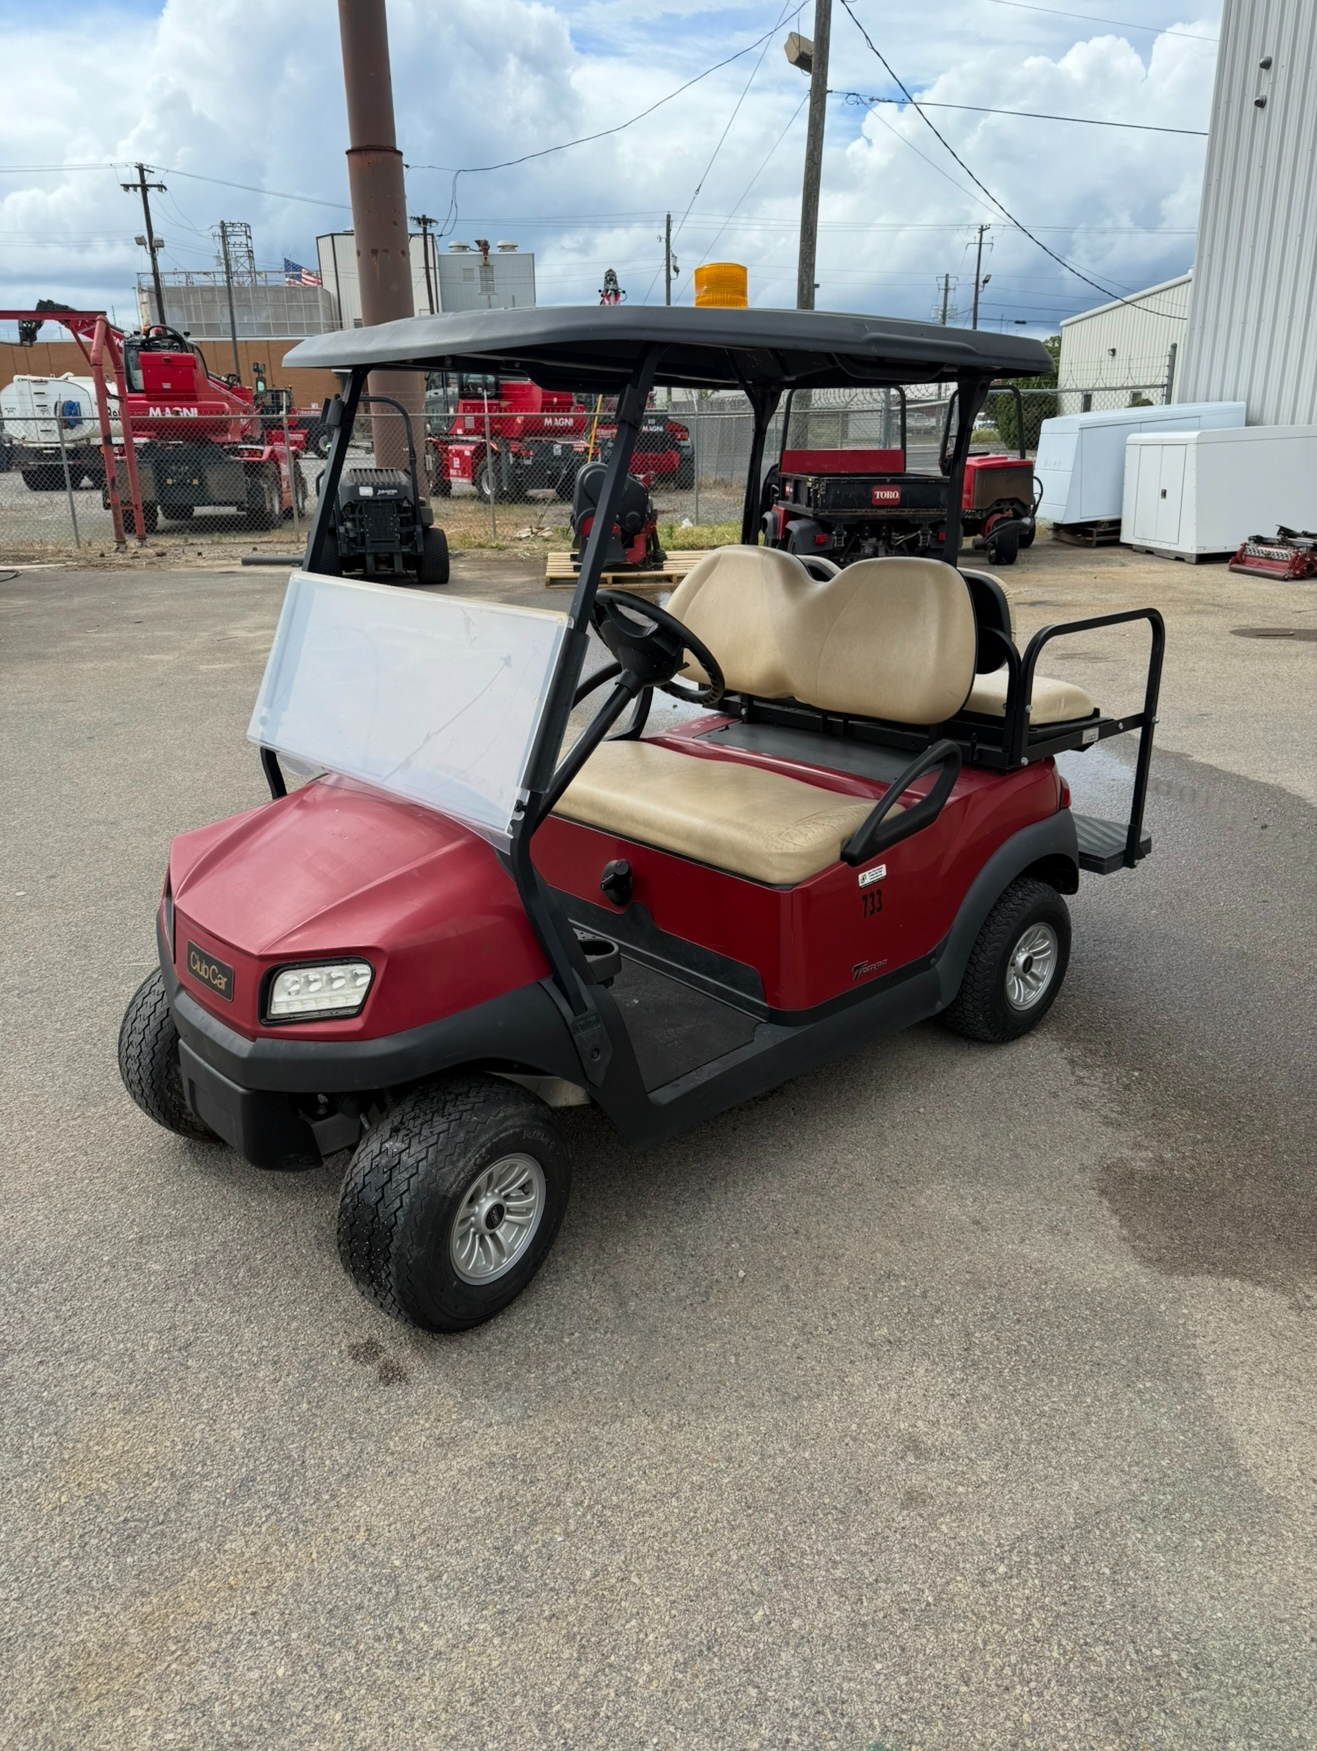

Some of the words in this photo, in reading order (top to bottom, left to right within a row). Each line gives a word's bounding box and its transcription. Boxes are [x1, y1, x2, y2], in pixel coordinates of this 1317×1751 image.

[148, 407, 199, 418] MAGNI
[543, 417, 574, 427] MAGNI
[641, 425, 664, 433] MAGNI
[874, 490, 900, 499] TORO
[862, 889, 883, 918] 733
[190, 951, 209, 979] Club
[210, 965, 227, 990] Car
